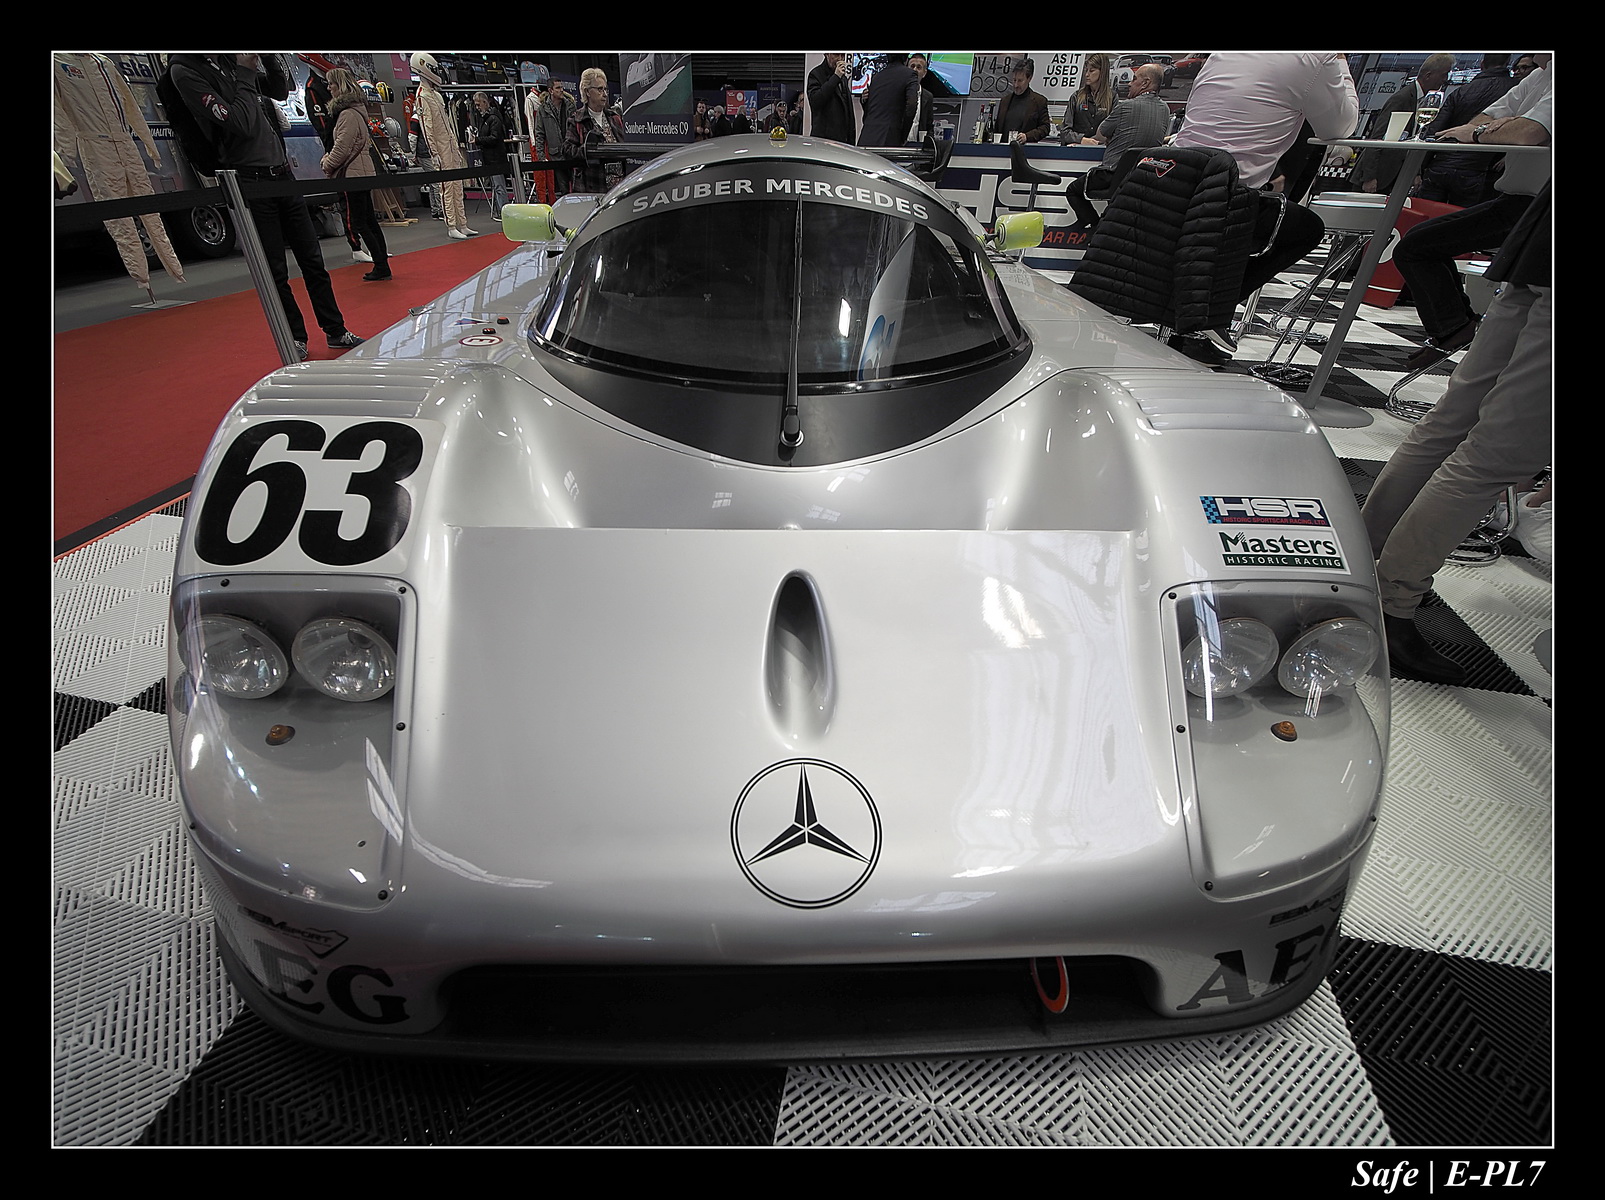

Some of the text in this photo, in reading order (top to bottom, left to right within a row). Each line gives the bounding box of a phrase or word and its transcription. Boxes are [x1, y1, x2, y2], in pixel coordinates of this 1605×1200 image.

[989, 56, 1011, 74] 4-8
[1051, 53, 1082, 64] AS IT
[1046, 65, 1079, 76] USED
[970, 76, 1009, 92] 020
[1042, 77, 1077, 87] TO BE
[624, 121, 689, 135] Sauber-Mercedes C9
[632, 178, 929, 220] SAUBER MERCEDES
[929, 174, 1079, 227] HS
[1043, 231, 1087, 245] AR RA
[194, 419, 424, 567] 63
[1215, 498, 1325, 520] HSR
[1219, 531, 1337, 556] Masters
[1227, 556, 1342, 567] HISTORIC RACING
[1176, 924, 1326, 1011] AE
[253, 938, 411, 1025] EG
